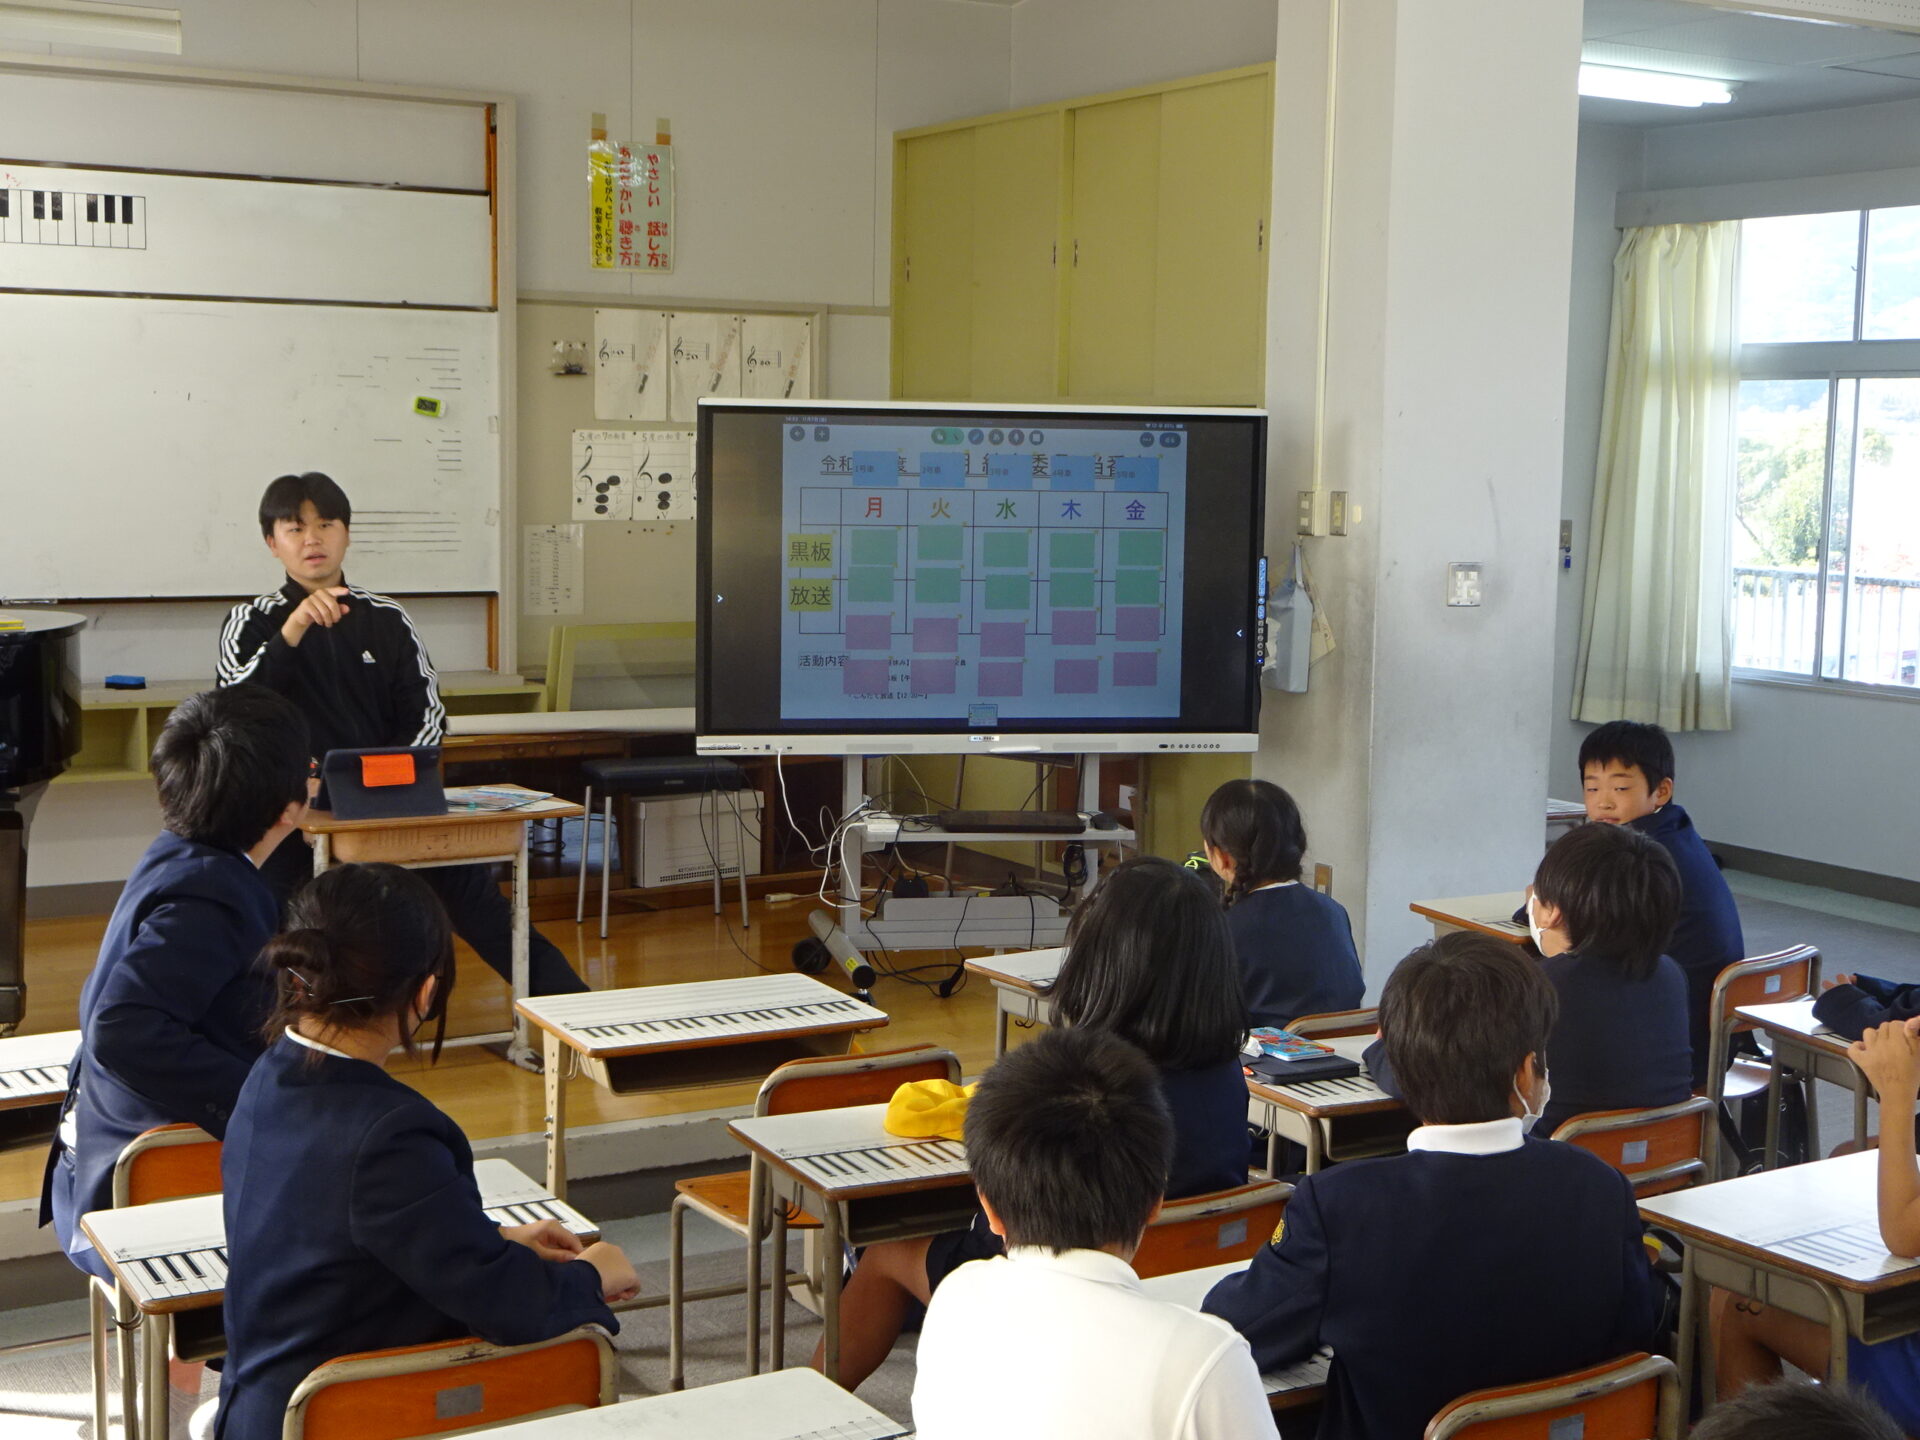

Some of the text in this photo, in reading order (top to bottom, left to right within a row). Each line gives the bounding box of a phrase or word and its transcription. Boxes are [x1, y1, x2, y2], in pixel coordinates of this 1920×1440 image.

[647, 153, 660, 267] やさしい 話し方
[618, 219, 634, 266] 聴き方
[865, 497, 882, 518] 月
[930, 498, 951, 519] 火
[995, 498, 1017, 520] 水
[1061, 499, 1082, 520] 木
[1125, 499, 1146, 521] 金
[790, 541, 831, 562] 黒板
[790, 586, 831, 606] 放送
[799, 654, 849, 668] 活動内容
